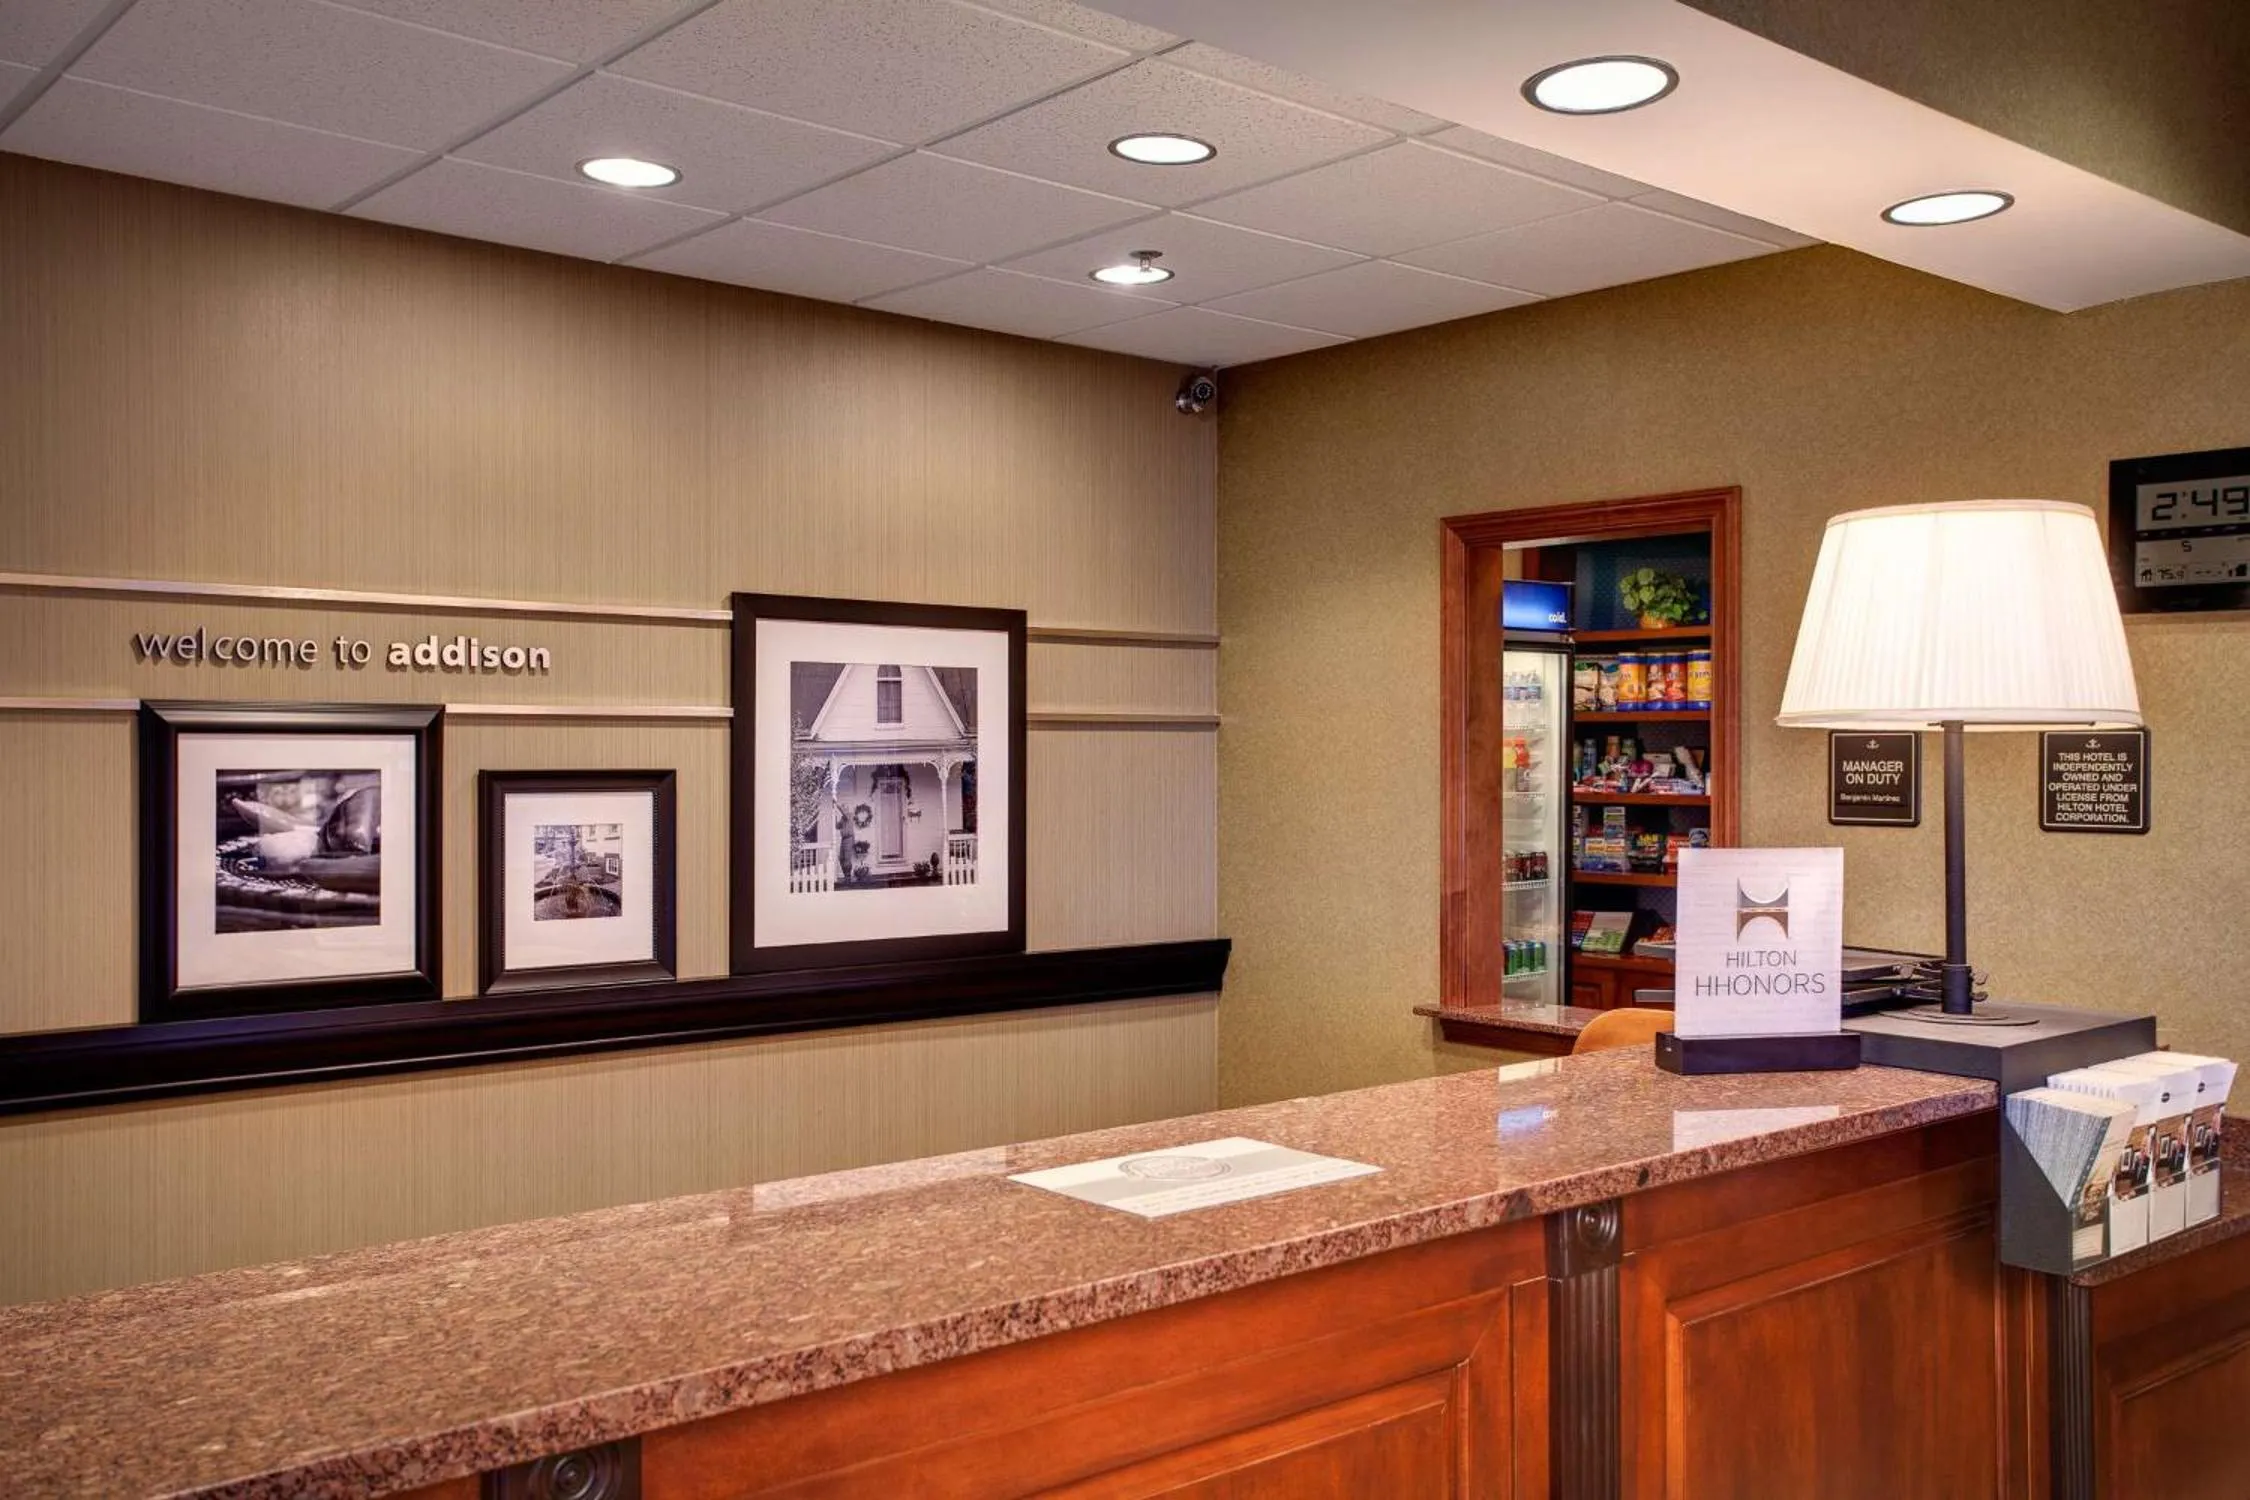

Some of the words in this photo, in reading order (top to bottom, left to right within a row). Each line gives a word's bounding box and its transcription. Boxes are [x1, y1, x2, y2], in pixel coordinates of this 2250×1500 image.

[2152, 486, 2249, 521] 2:49
[137, 625, 318, 664] welcome
[335, 635, 371, 664] to
[388, 635, 550, 669] addison
[2058, 752, 2080, 761] THIS
[2083, 752, 2115, 761] HOTEL
[2117, 752, 2128, 761] IS
[1842, 760, 1904, 772] MANAGER
[2052, 762, 2133, 772] INDEPENDENTLY
[1845, 773, 1864, 785] ON
[1866, 773, 1901, 785] DUTY
[2062, 772, 2100, 782] OWNED
[2101, 773, 2123, 782] AND
[2048, 782, 2100, 792] OPERATED
[2102, 783, 2137, 793] UNDER
[2055, 792, 2098, 802] LICENSE
[2099, 792, 2129, 803] FROM
[2057, 802, 2092, 812] HILTON
[2094, 803, 2129, 813] HOTEL
[1726, 950, 1797, 968] HILTON
[1695, 973, 1825, 997] HHONORS
